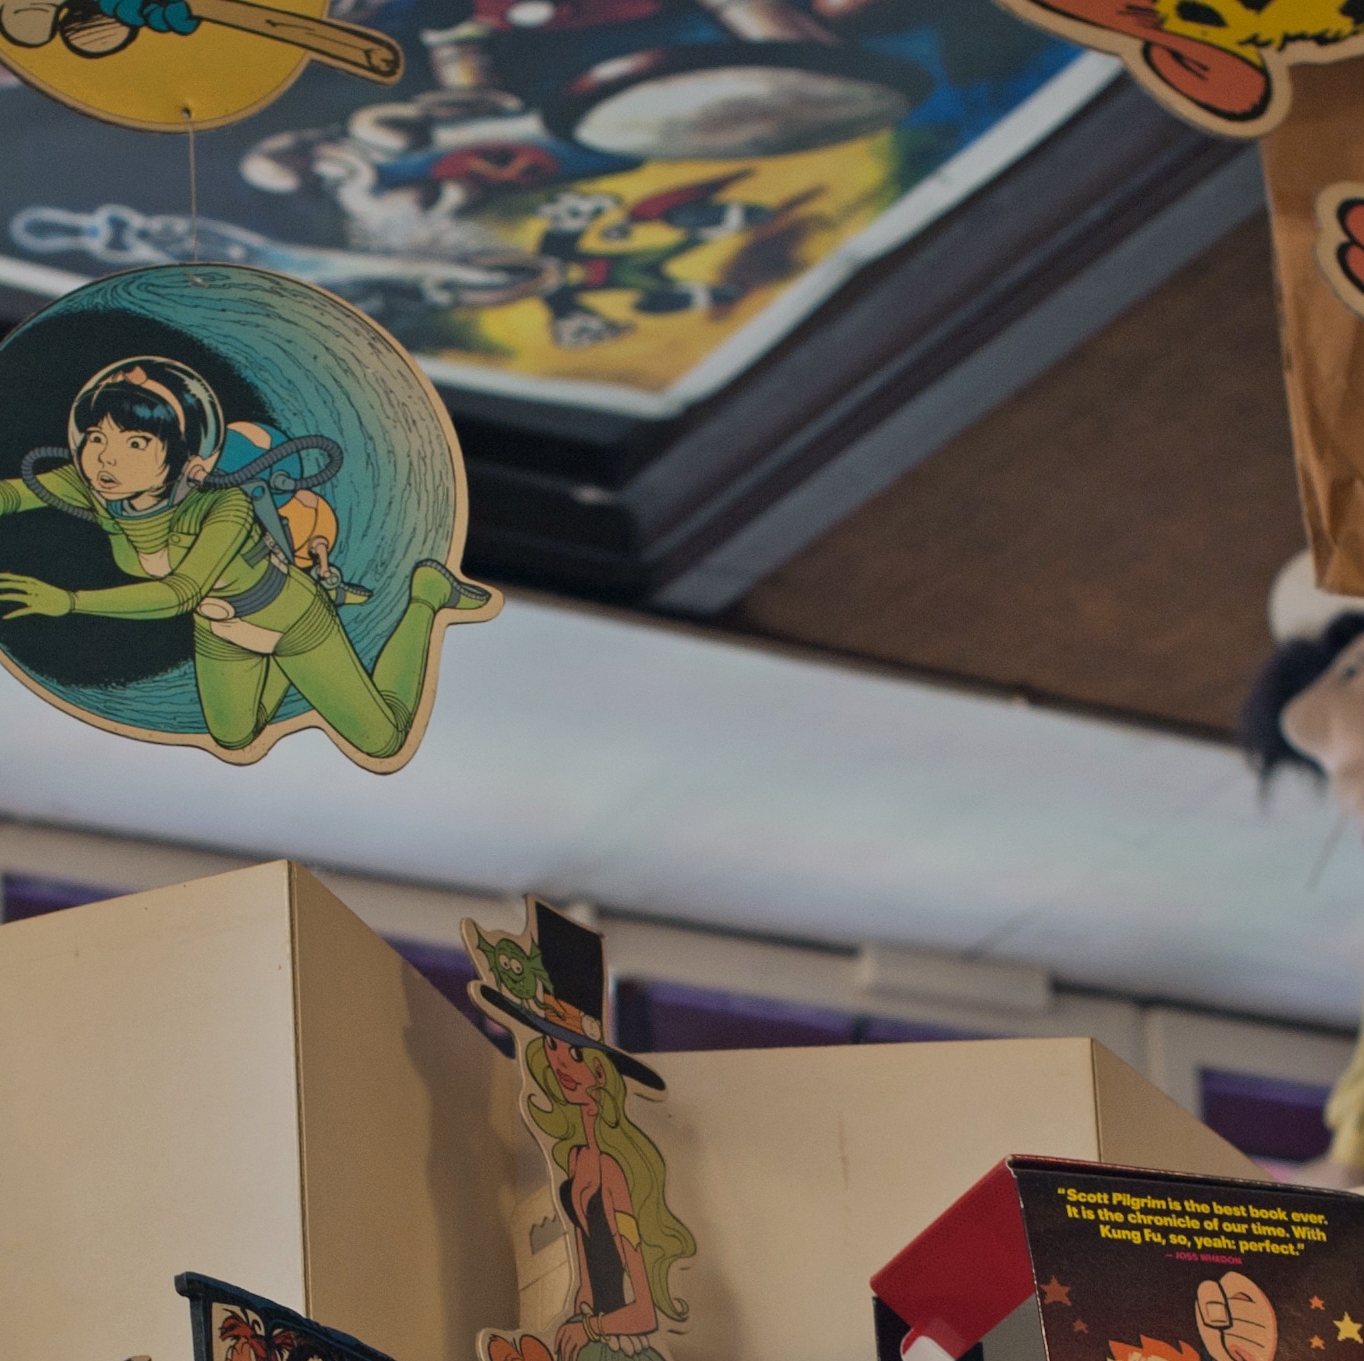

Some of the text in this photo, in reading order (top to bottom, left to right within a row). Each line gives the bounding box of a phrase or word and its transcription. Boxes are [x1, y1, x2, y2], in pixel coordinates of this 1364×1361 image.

[1066, 1205, 1328, 1242] It is the chronicle of our time. With
[1112, 1192, 1167, 1210] Pilgrim
[1168, 1197, 1182, 1209] is
[1184, 1199, 1210, 1214] the
[1213, 1202, 1247, 1217] best
[1249, 1205, 1288, 1221] book
[1291, 1211, 1329, 1226] ever.
[1099, 1225, 1305, 1256] Kung Fu, so, yeah: perfect."
